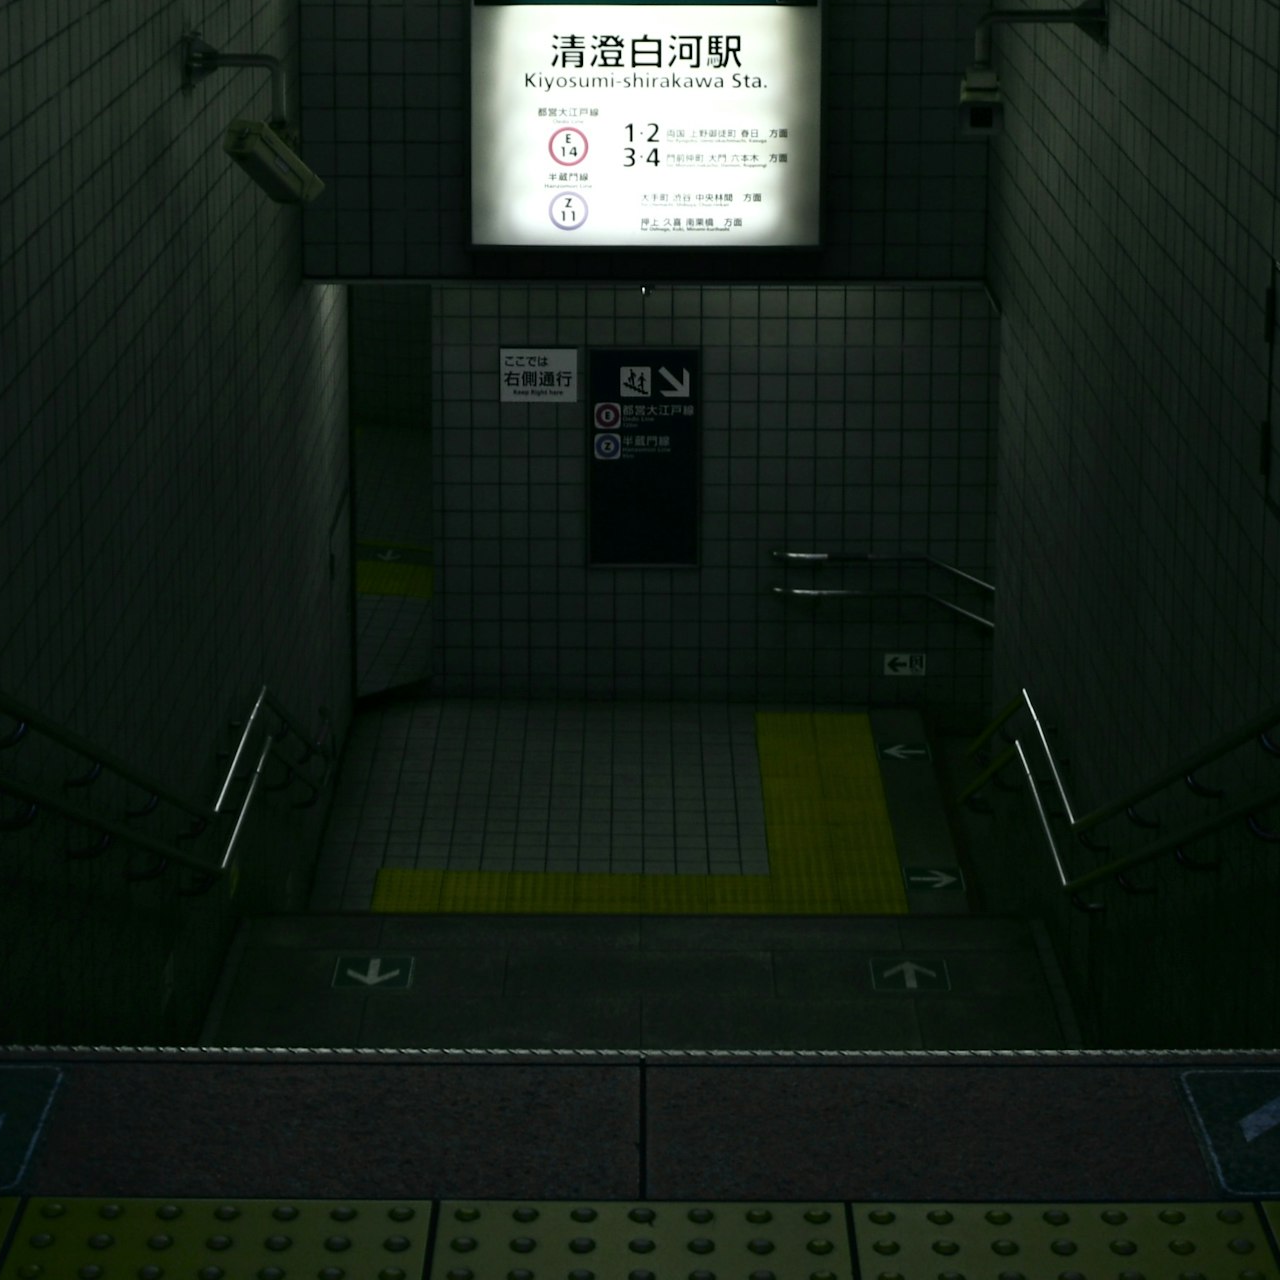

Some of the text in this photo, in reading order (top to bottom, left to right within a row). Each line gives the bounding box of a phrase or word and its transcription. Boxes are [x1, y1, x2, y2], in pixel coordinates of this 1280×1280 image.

[550, 33, 743, 69] 清澄白河駅
[524, 72, 768, 92] Kiyosumi-shirakawa Sta.
[537, 107, 599, 118] 都営大江戸線
[565, 133, 572, 144] E
[561, 146, 578, 157] 14
[548, 172, 589, 182] 半蔵門線
[743, 193, 762, 202] 方面
[564, 198, 573, 209] Z
[561, 210, 576, 222] 11
[724, 218, 742, 227] 方面
[505, 356, 548, 367] ここでは
[504, 371, 572, 386] 右側通行
[622, 404, 695, 416] 都営大江戸線
[604, 442, 611, 450] Z
[622, 435, 671, 447] 半蔵門線
